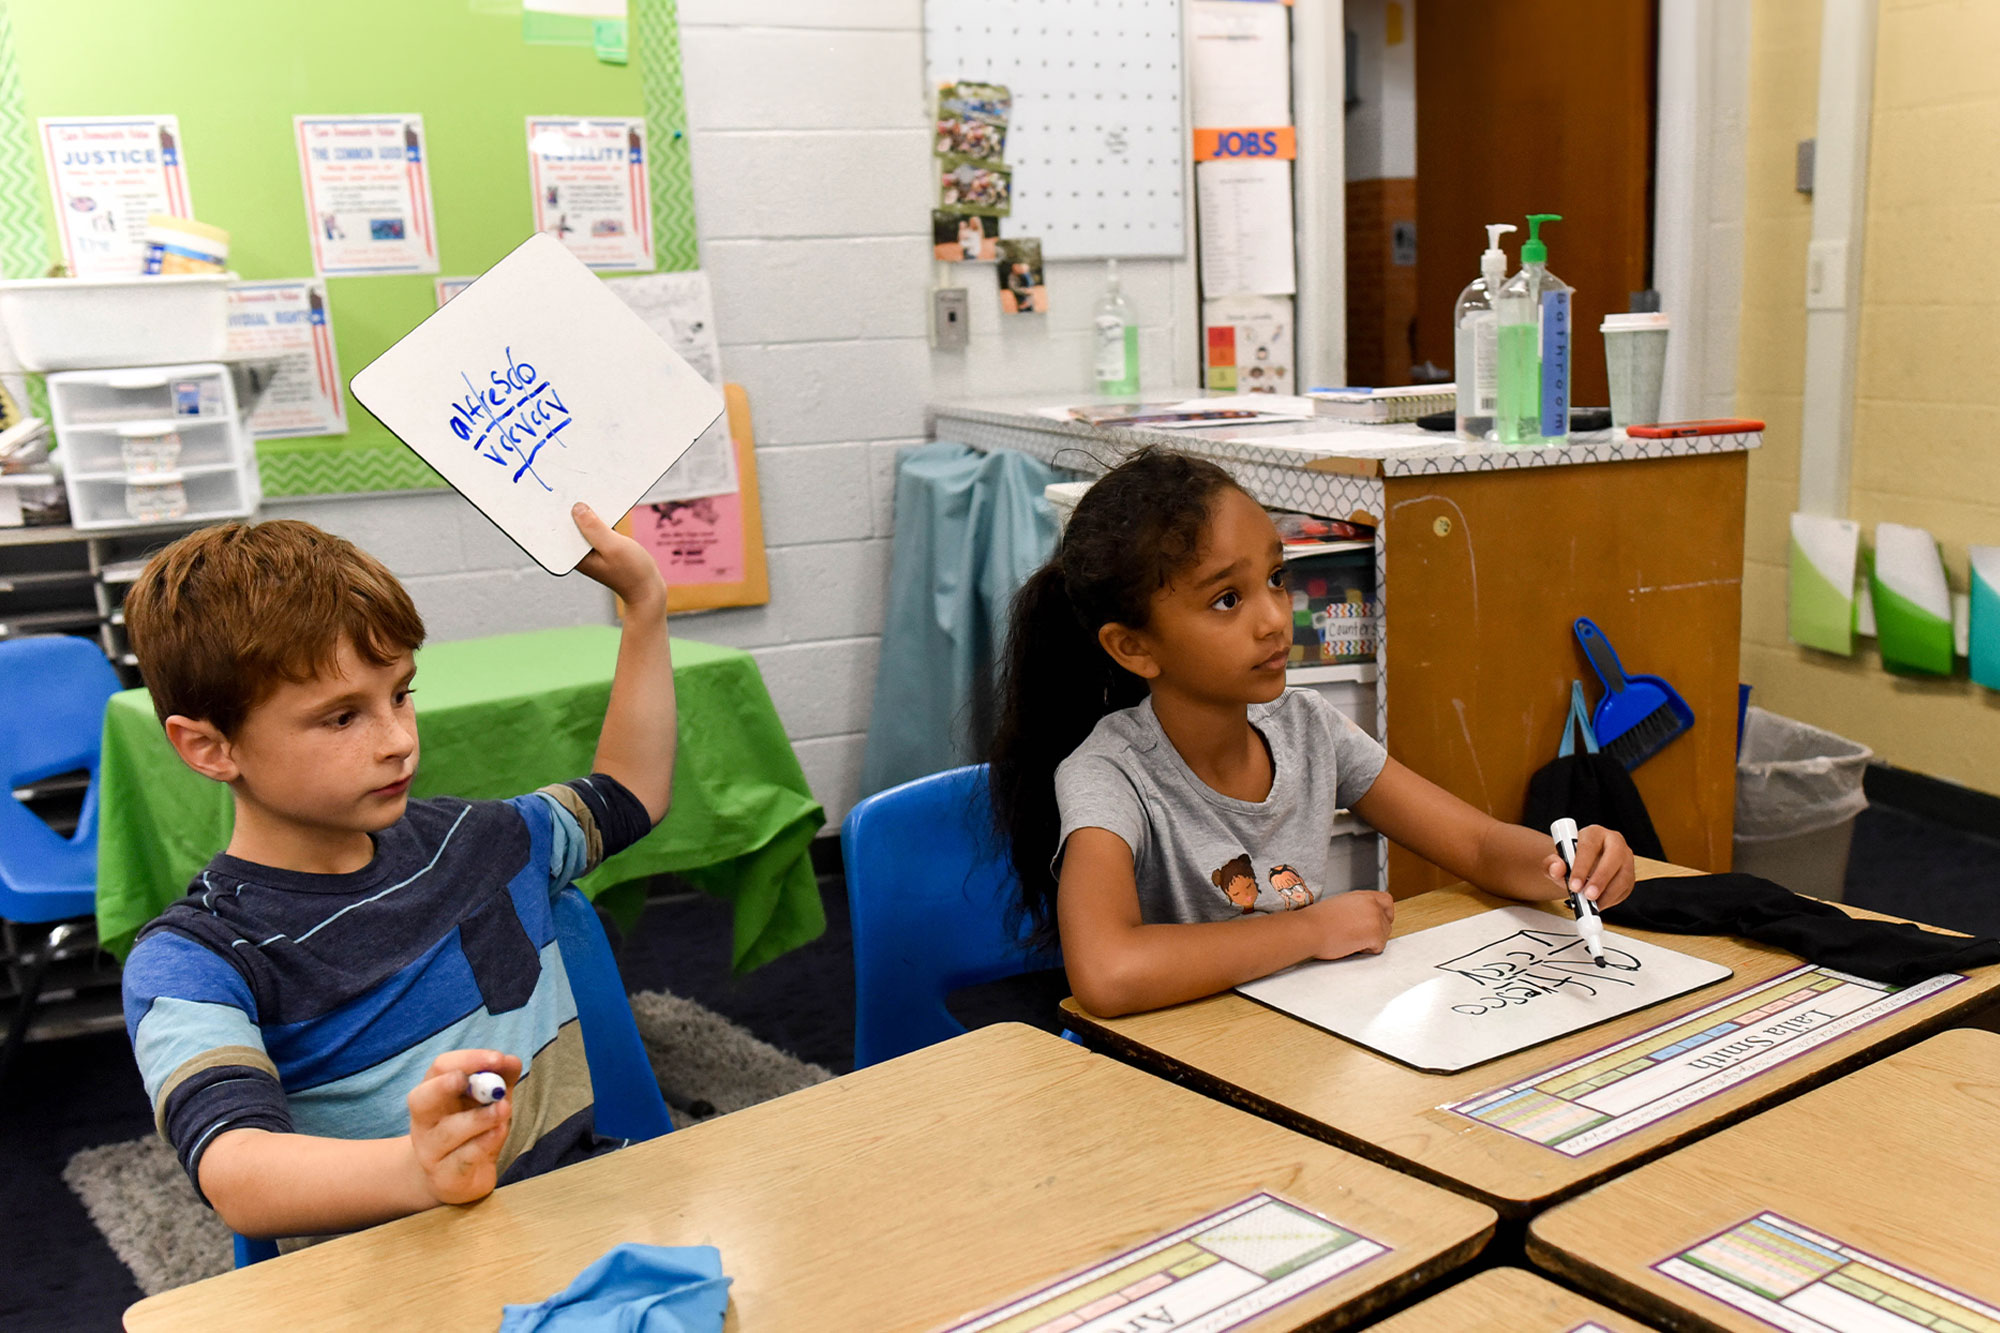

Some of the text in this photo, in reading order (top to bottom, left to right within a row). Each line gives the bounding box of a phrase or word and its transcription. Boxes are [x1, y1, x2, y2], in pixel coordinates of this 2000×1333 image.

[64, 148, 156, 165] JUSTICE
[1212, 131, 1278, 157] JOBS
[1329, 622, 1377, 637] Counters
[1763, 1008, 1838, 1037] Laila
[1688, 1035, 1775, 1069] Smith
